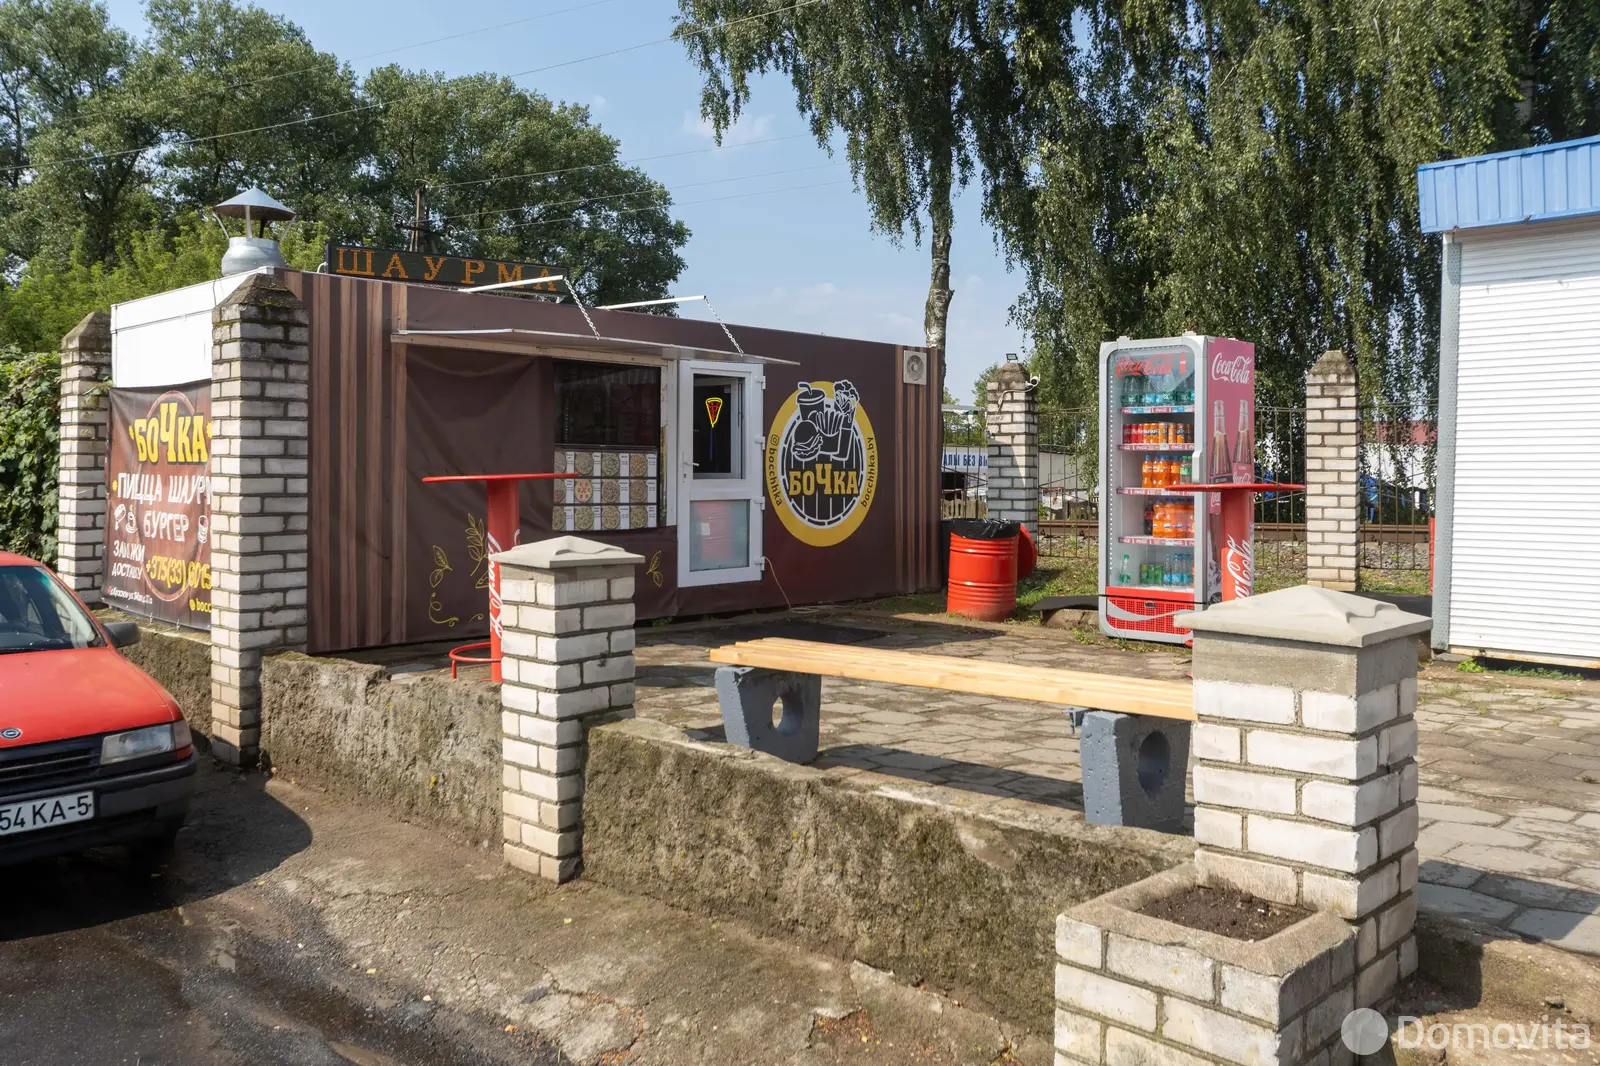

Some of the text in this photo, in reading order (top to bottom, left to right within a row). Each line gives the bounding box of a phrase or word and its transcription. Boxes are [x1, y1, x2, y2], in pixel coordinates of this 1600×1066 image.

[336, 248, 557, 291] ШАУРМА
[1211, 352, 1252, 385] Coca-Cola
[134, 402, 208, 463] БОЧКА
[117, 472, 162, 505] ПИЦЦА
[768, 447, 783, 507] bocchhka
[789, 464, 859, 496] БОЧКА
[861, 436, 875, 508] bocchhka.by
[143, 510, 189, 542] БУРГЕР
[32, 795, 91, 826] KA-5
